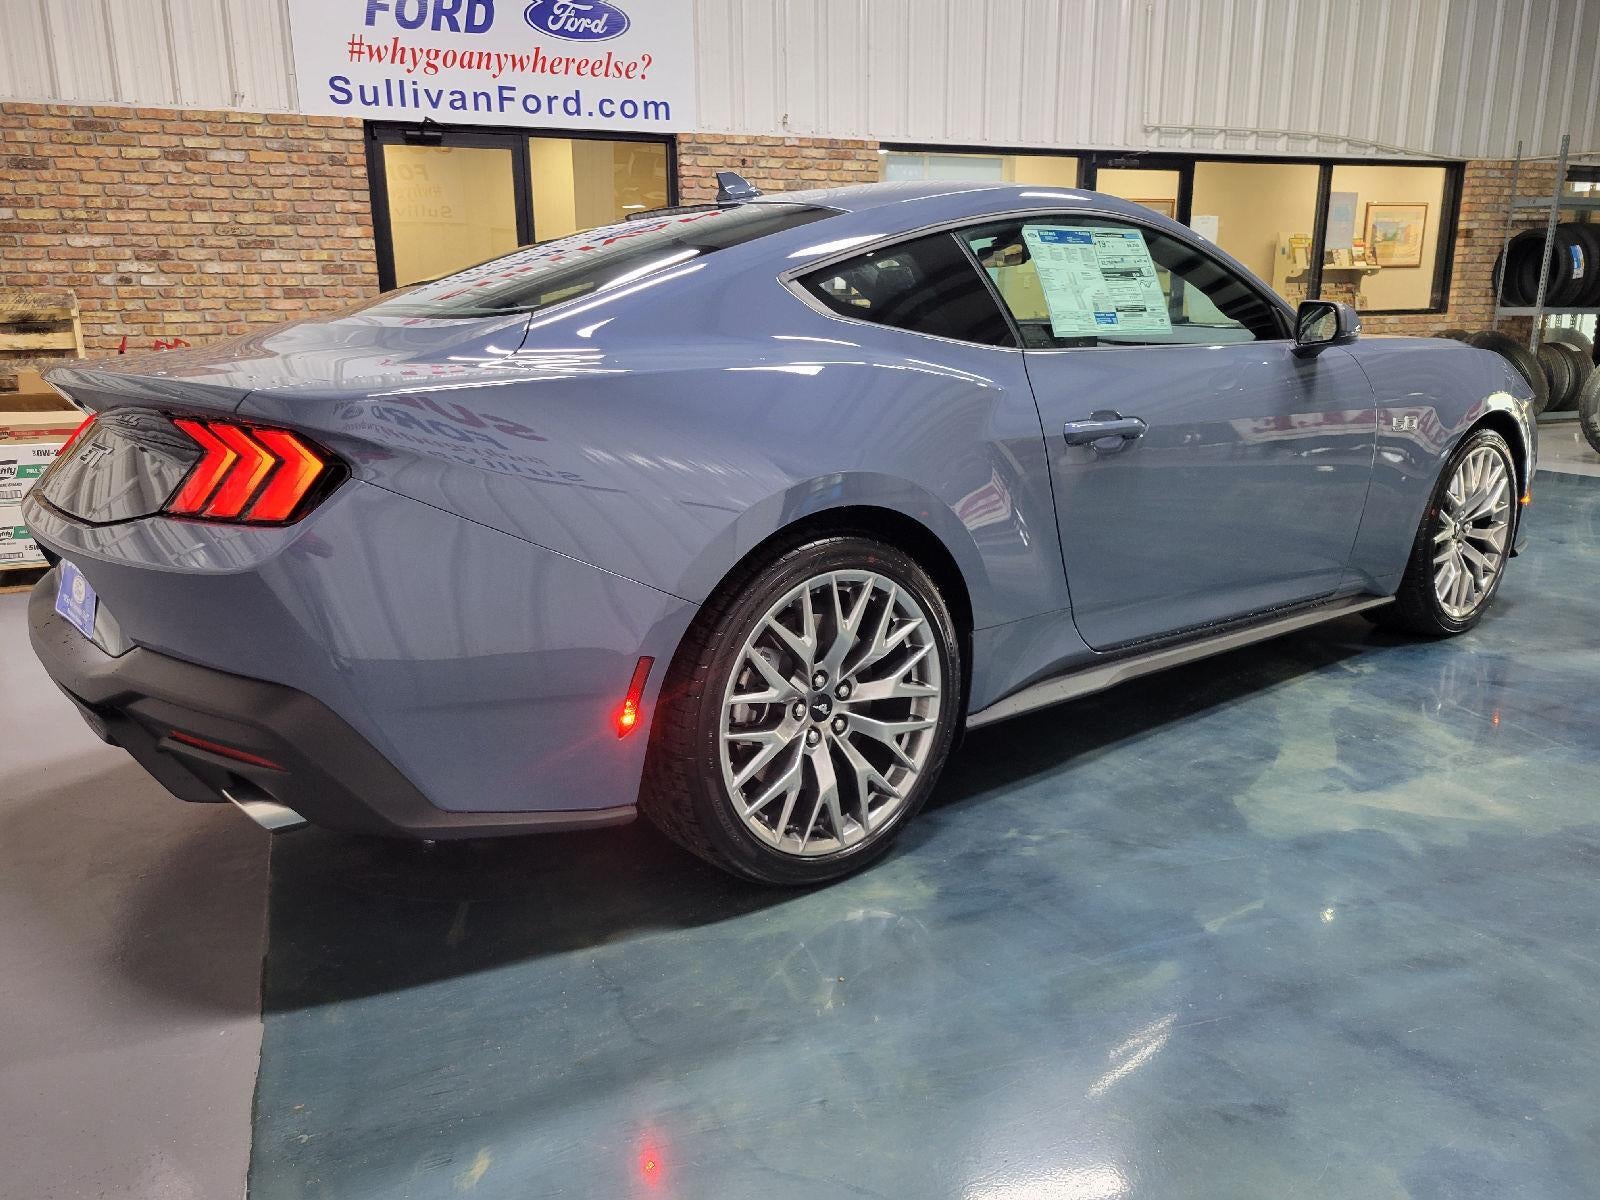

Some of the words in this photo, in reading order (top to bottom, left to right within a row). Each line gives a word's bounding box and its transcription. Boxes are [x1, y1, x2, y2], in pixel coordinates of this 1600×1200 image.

[365, 0, 495, 34] FORD
[547, 0, 609, 34] Ford
[347, 34, 653, 80] #whygoanywhereelse?
[328, 76, 671, 121] SullivanFord.com
